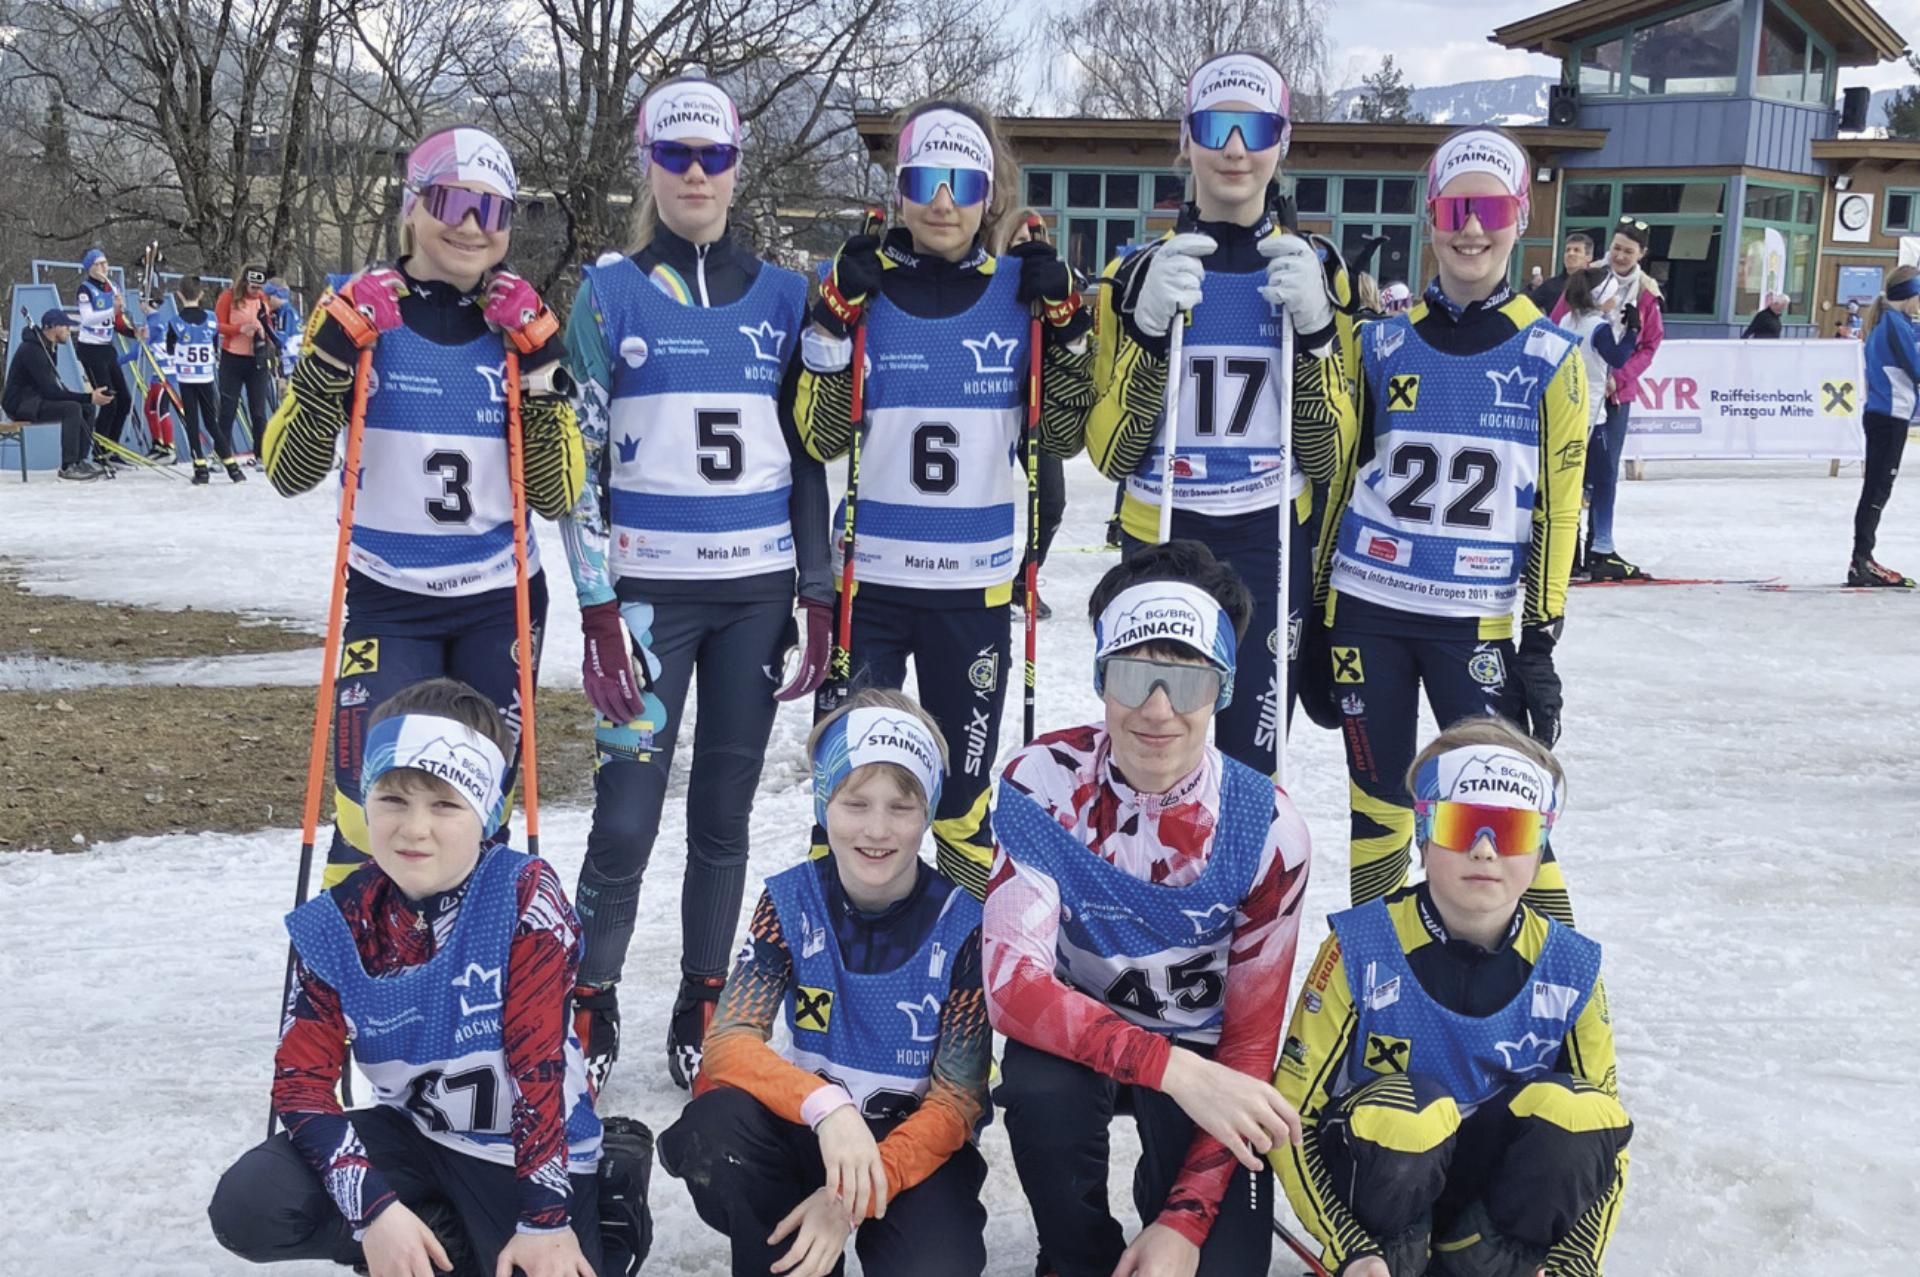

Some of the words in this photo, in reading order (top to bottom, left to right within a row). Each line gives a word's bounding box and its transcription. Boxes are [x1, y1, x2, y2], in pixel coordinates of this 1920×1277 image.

[1201, 78, 1266, 98] STAINACH
[656, 112, 720, 132] STAINACH
[1447, 152, 1511, 175] STAINACH
[824, 284, 850, 319] LEKI
[1259, 324, 1281, 337] HOC
[187, 347, 210, 363] 56
[1189, 356, 1270, 437] 17
[1710, 389, 1813, 402] Raiffeisenbank
[476, 409, 505, 423] HOC
[1720, 405, 1776, 420] Pinzgau
[1780, 405, 1814, 417] Mitte
[694, 408, 746, 485] 5
[854, 432, 862, 484] LEKI
[910, 421, 960, 496] 6
[1028, 439, 1038, 491] LEKI
[423, 449, 474, 525] 3
[1386, 441, 1502, 530] 22
[697, 547, 729, 560] Maria
[731, 546, 751, 559] Alm
[905, 554, 935, 570] Maria
[937, 556, 960, 570] Alm
[427, 578, 458, 592] Maria
[1368, 570, 1427, 594] Interbancario
[1429, 585, 1466, 600] Europeo
[1468, 589, 1488, 600] 2019
[1145, 608, 1197, 622] BG/BRG
[1114, 622, 1195, 647] STAINACH
[418, 758, 485, 801] STAINACH
[1501, 766, 1541, 791] BG/BRG
[1459, 778, 1538, 805] STAINACH
[1104, 951, 1225, 1020] 45
[455, 1016, 503, 1044] HOCHK
[896, 1048, 933, 1066] HOCH
